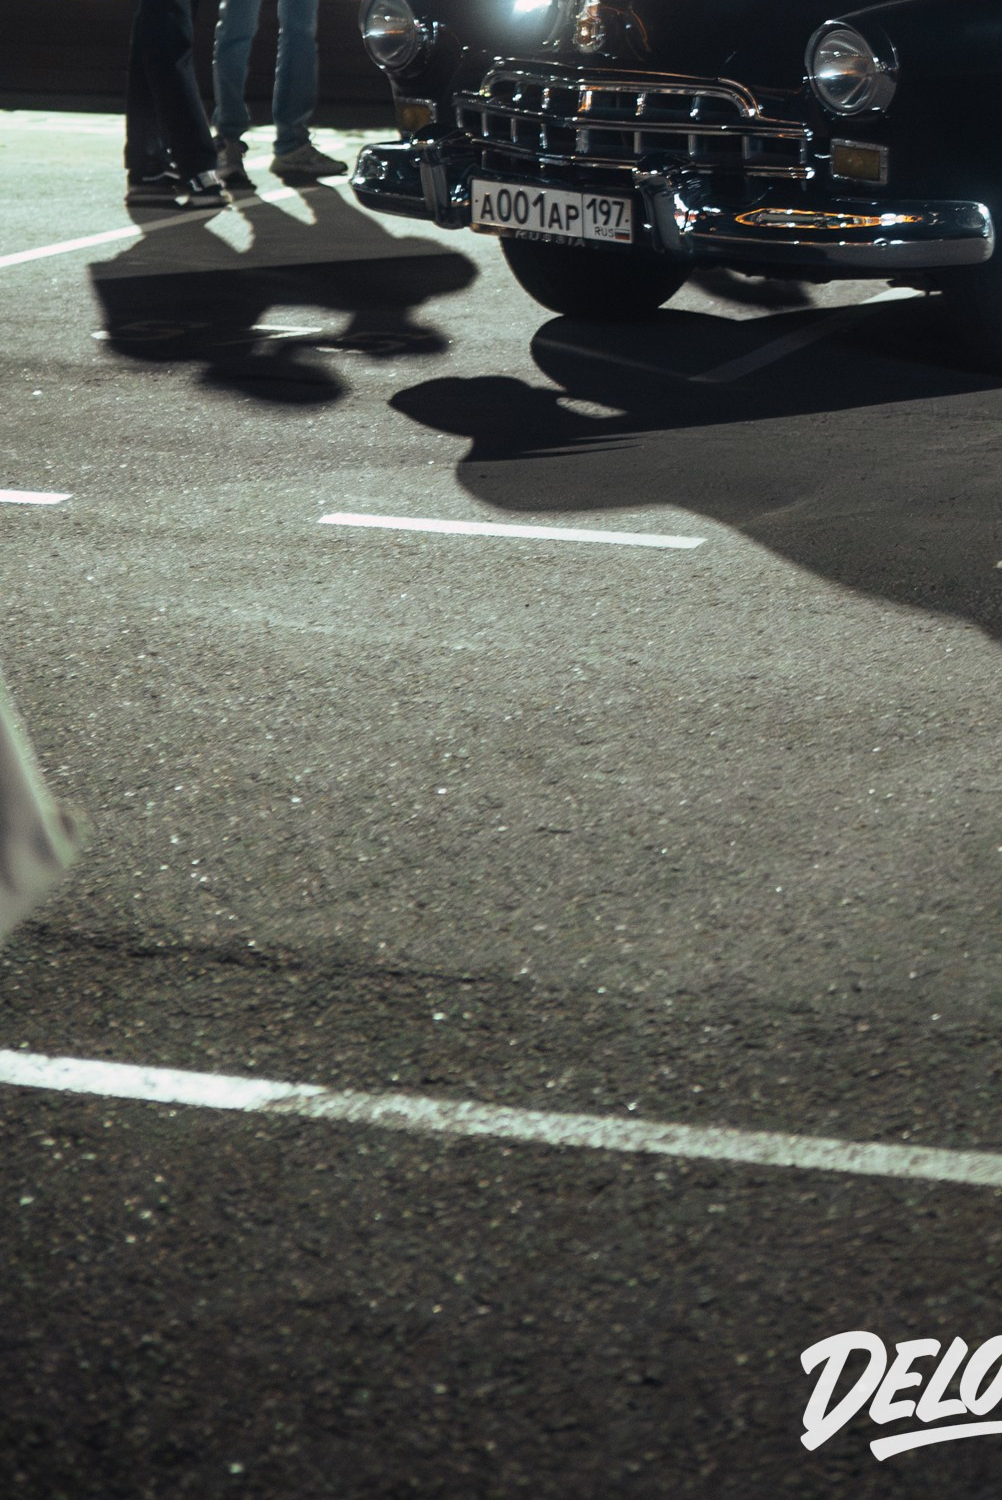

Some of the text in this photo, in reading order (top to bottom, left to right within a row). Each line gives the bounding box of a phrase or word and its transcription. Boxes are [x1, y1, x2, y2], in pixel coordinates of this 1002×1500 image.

[480, 188, 625, 231] A001AP 197
[515, 229, 586, 247] RUSSIA
[594, 227, 615, 238] RUS
